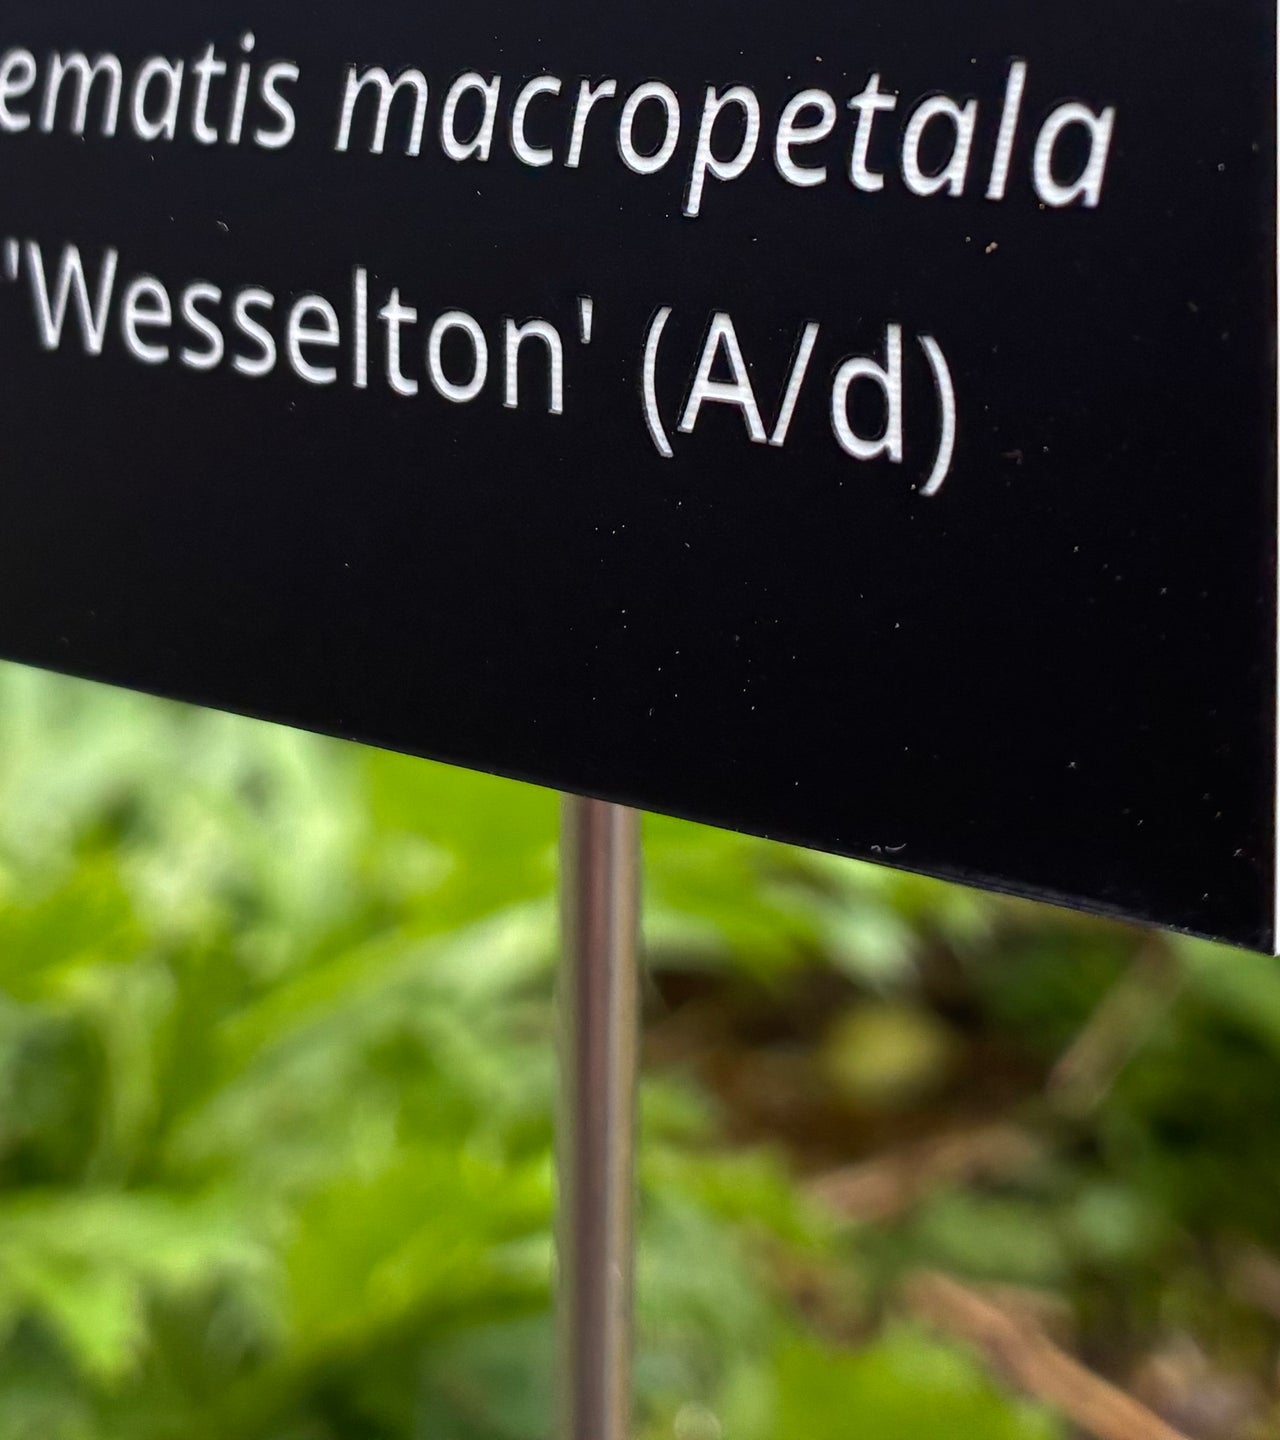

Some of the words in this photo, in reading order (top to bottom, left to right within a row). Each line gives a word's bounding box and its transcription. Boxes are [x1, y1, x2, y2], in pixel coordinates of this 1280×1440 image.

[333, 60, 1115, 219] macropetala
[6, 239, 594, 416] 'Wesselton'
[642, 306, 957, 497] (A/d)
